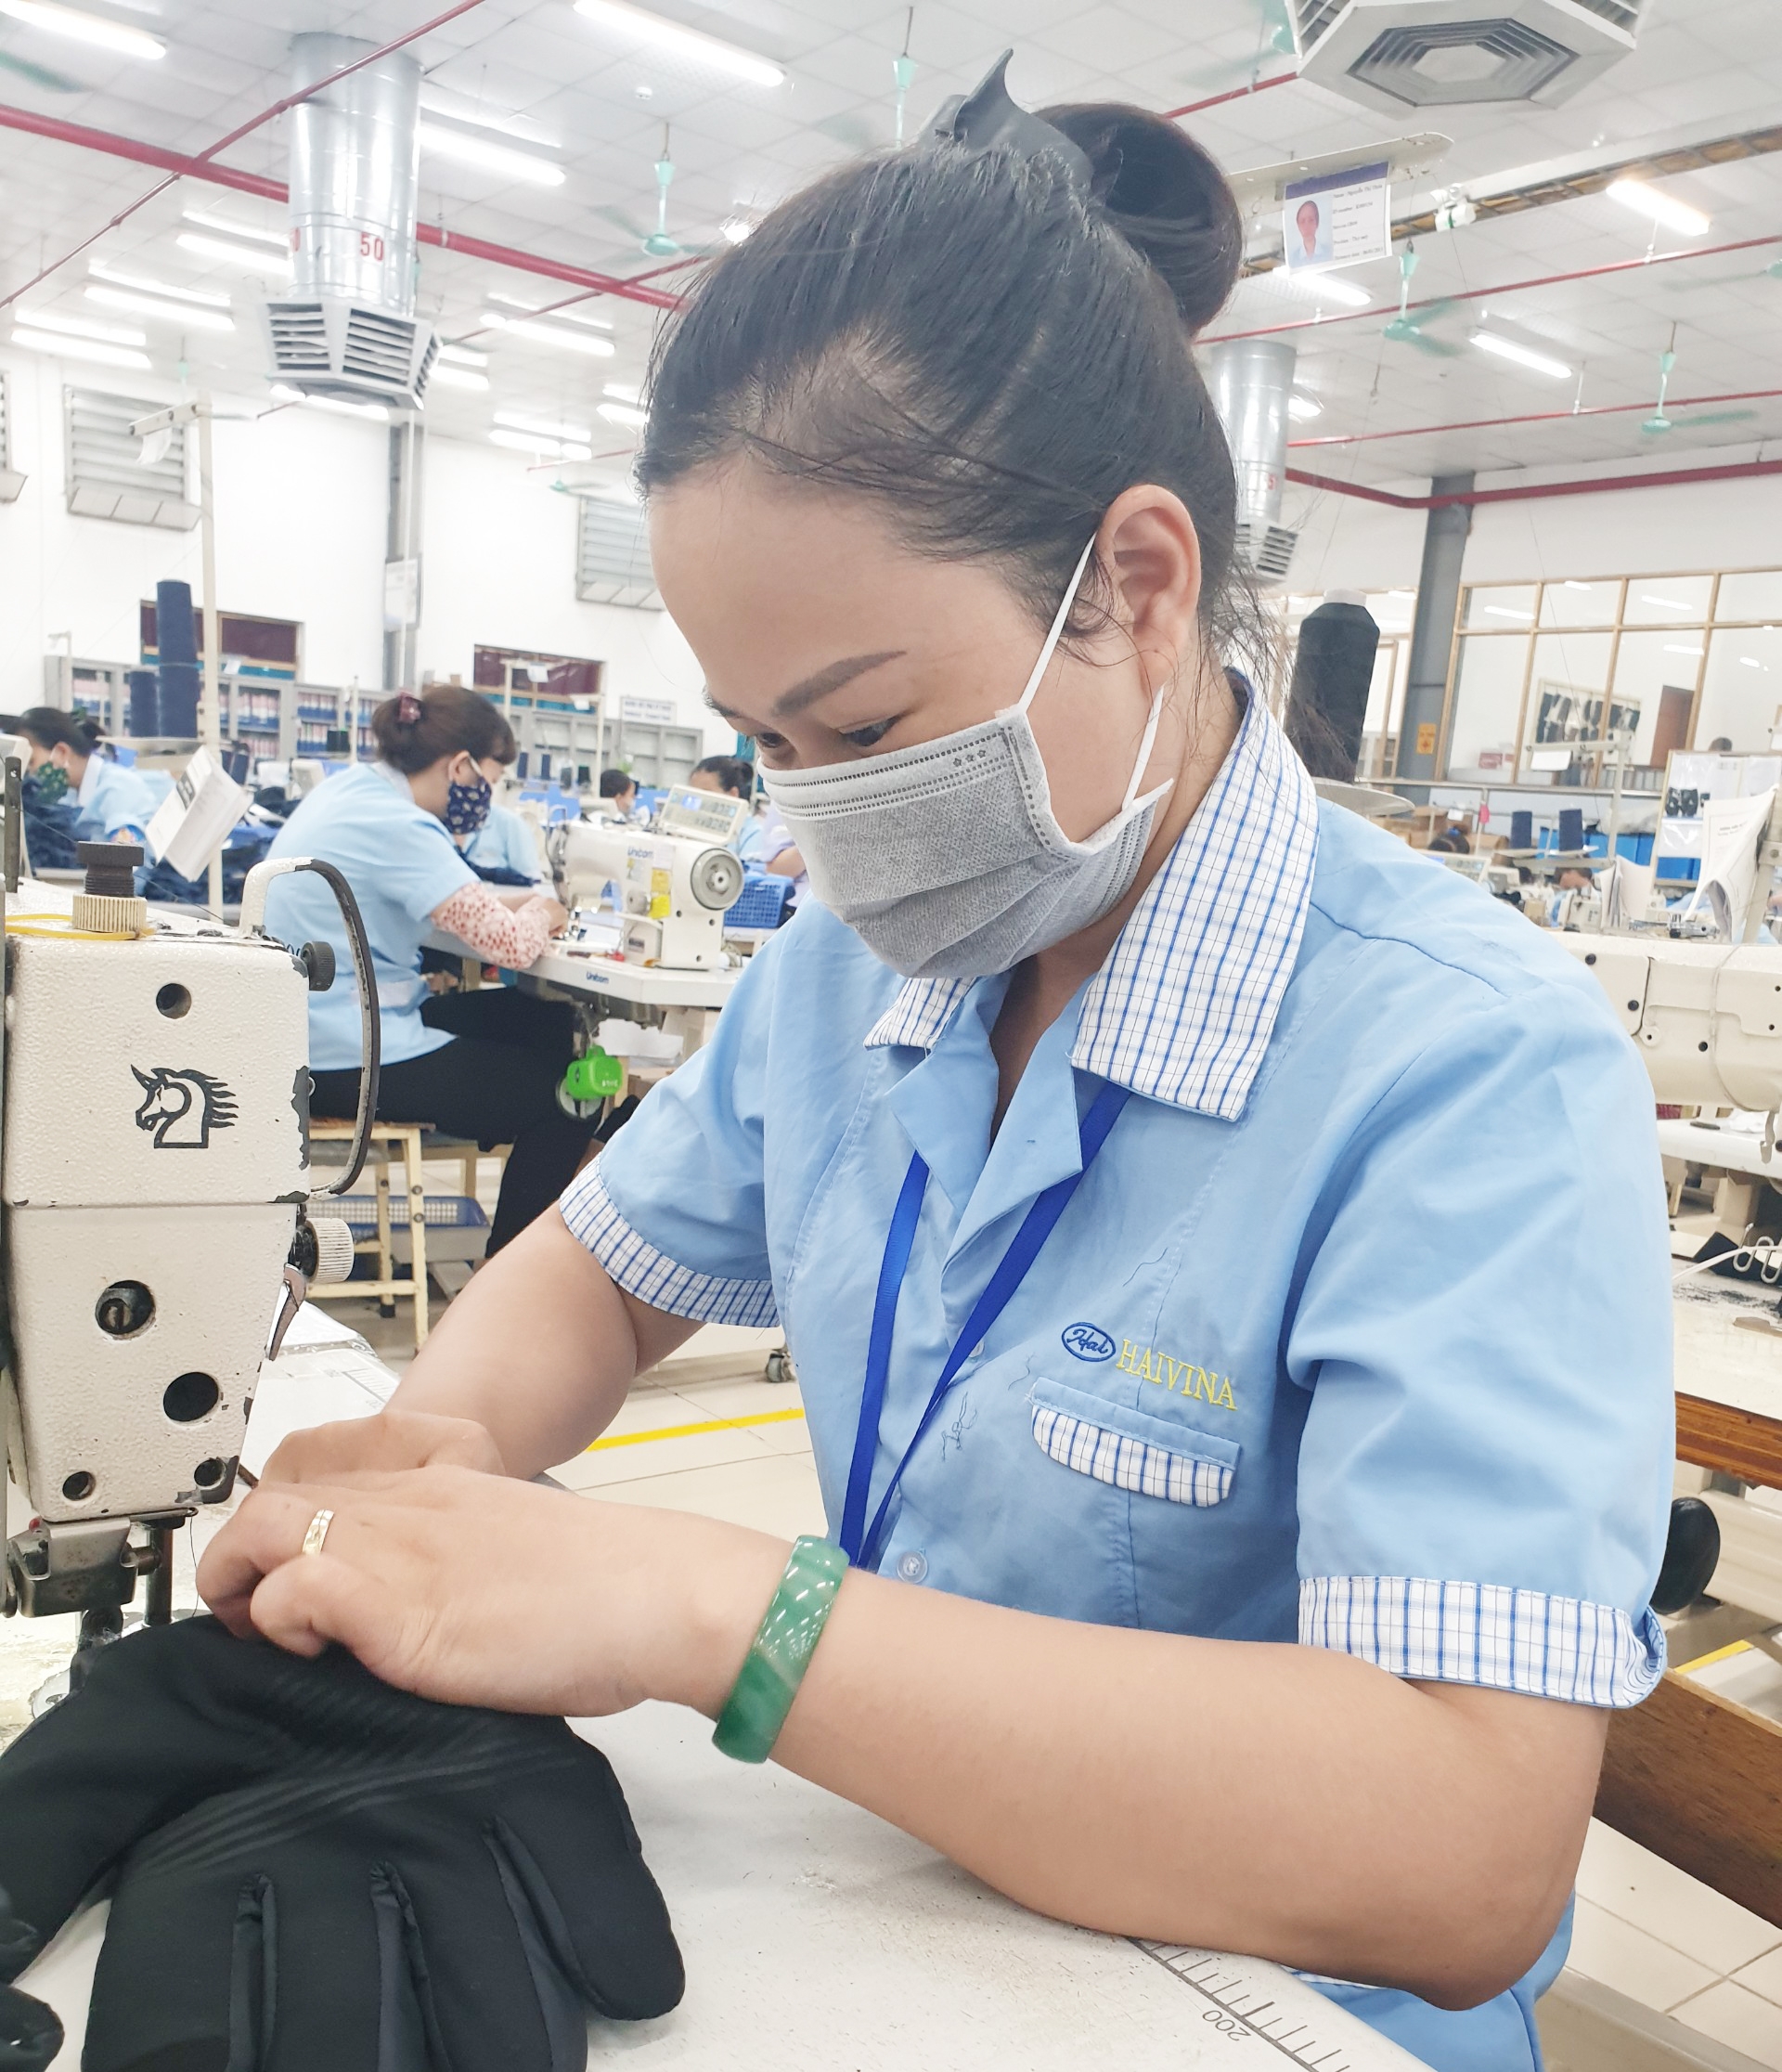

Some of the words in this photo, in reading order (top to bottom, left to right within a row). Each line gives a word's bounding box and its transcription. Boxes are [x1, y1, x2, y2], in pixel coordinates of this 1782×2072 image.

[360, 231, 384, 261] 50
[1116, 1339, 1237, 1410] HAIVINA
[1202, 2010, 1252, 2041] 200
